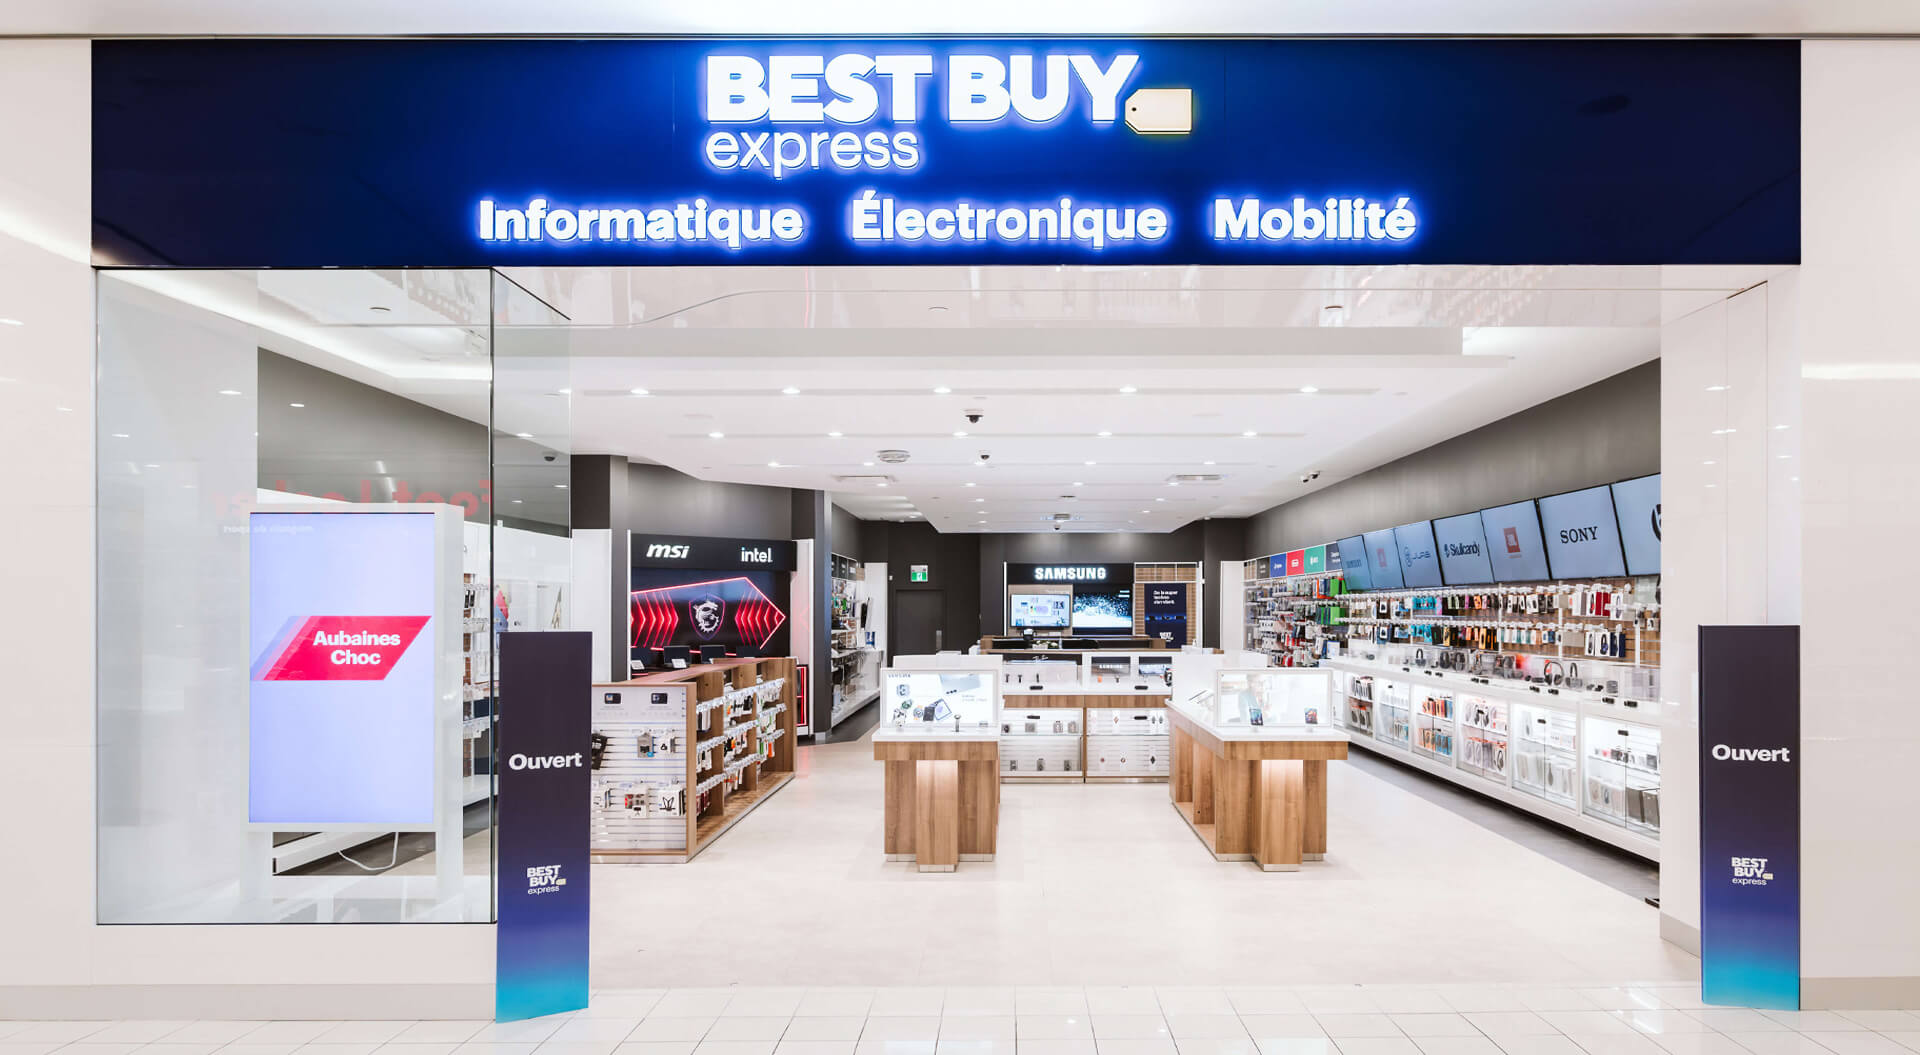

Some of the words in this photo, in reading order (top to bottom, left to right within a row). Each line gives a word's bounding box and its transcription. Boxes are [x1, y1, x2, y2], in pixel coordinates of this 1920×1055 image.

[707, 54, 933, 124] BEST
[949, 54, 1140, 124] BUY
[706, 132, 919, 180] express
[480, 199, 804, 250] Informatique
[852, 190, 1168, 249] Électronique
[1214, 197, 1416, 241] Mobilité
[1559, 526, 1598, 544] SONY
[646, 543, 690, 559] msi
[1449, 541, 1480, 557] Skullcandy
[1034, 567, 1107, 580] SAMSUNG
[313, 630, 401, 646] Aubaines
[330, 649, 381, 665] Choc
[1711, 744, 1791, 762] Ouvert
[508, 752, 583, 771] Ouvert
[1731, 856, 1768, 868] BEST
[526, 864, 562, 878] BEST
[1733, 867, 1765, 878] BUY
[529, 875, 558, 888] BUY
[1732, 877, 1767, 886] express
[527, 885, 560, 895] express
